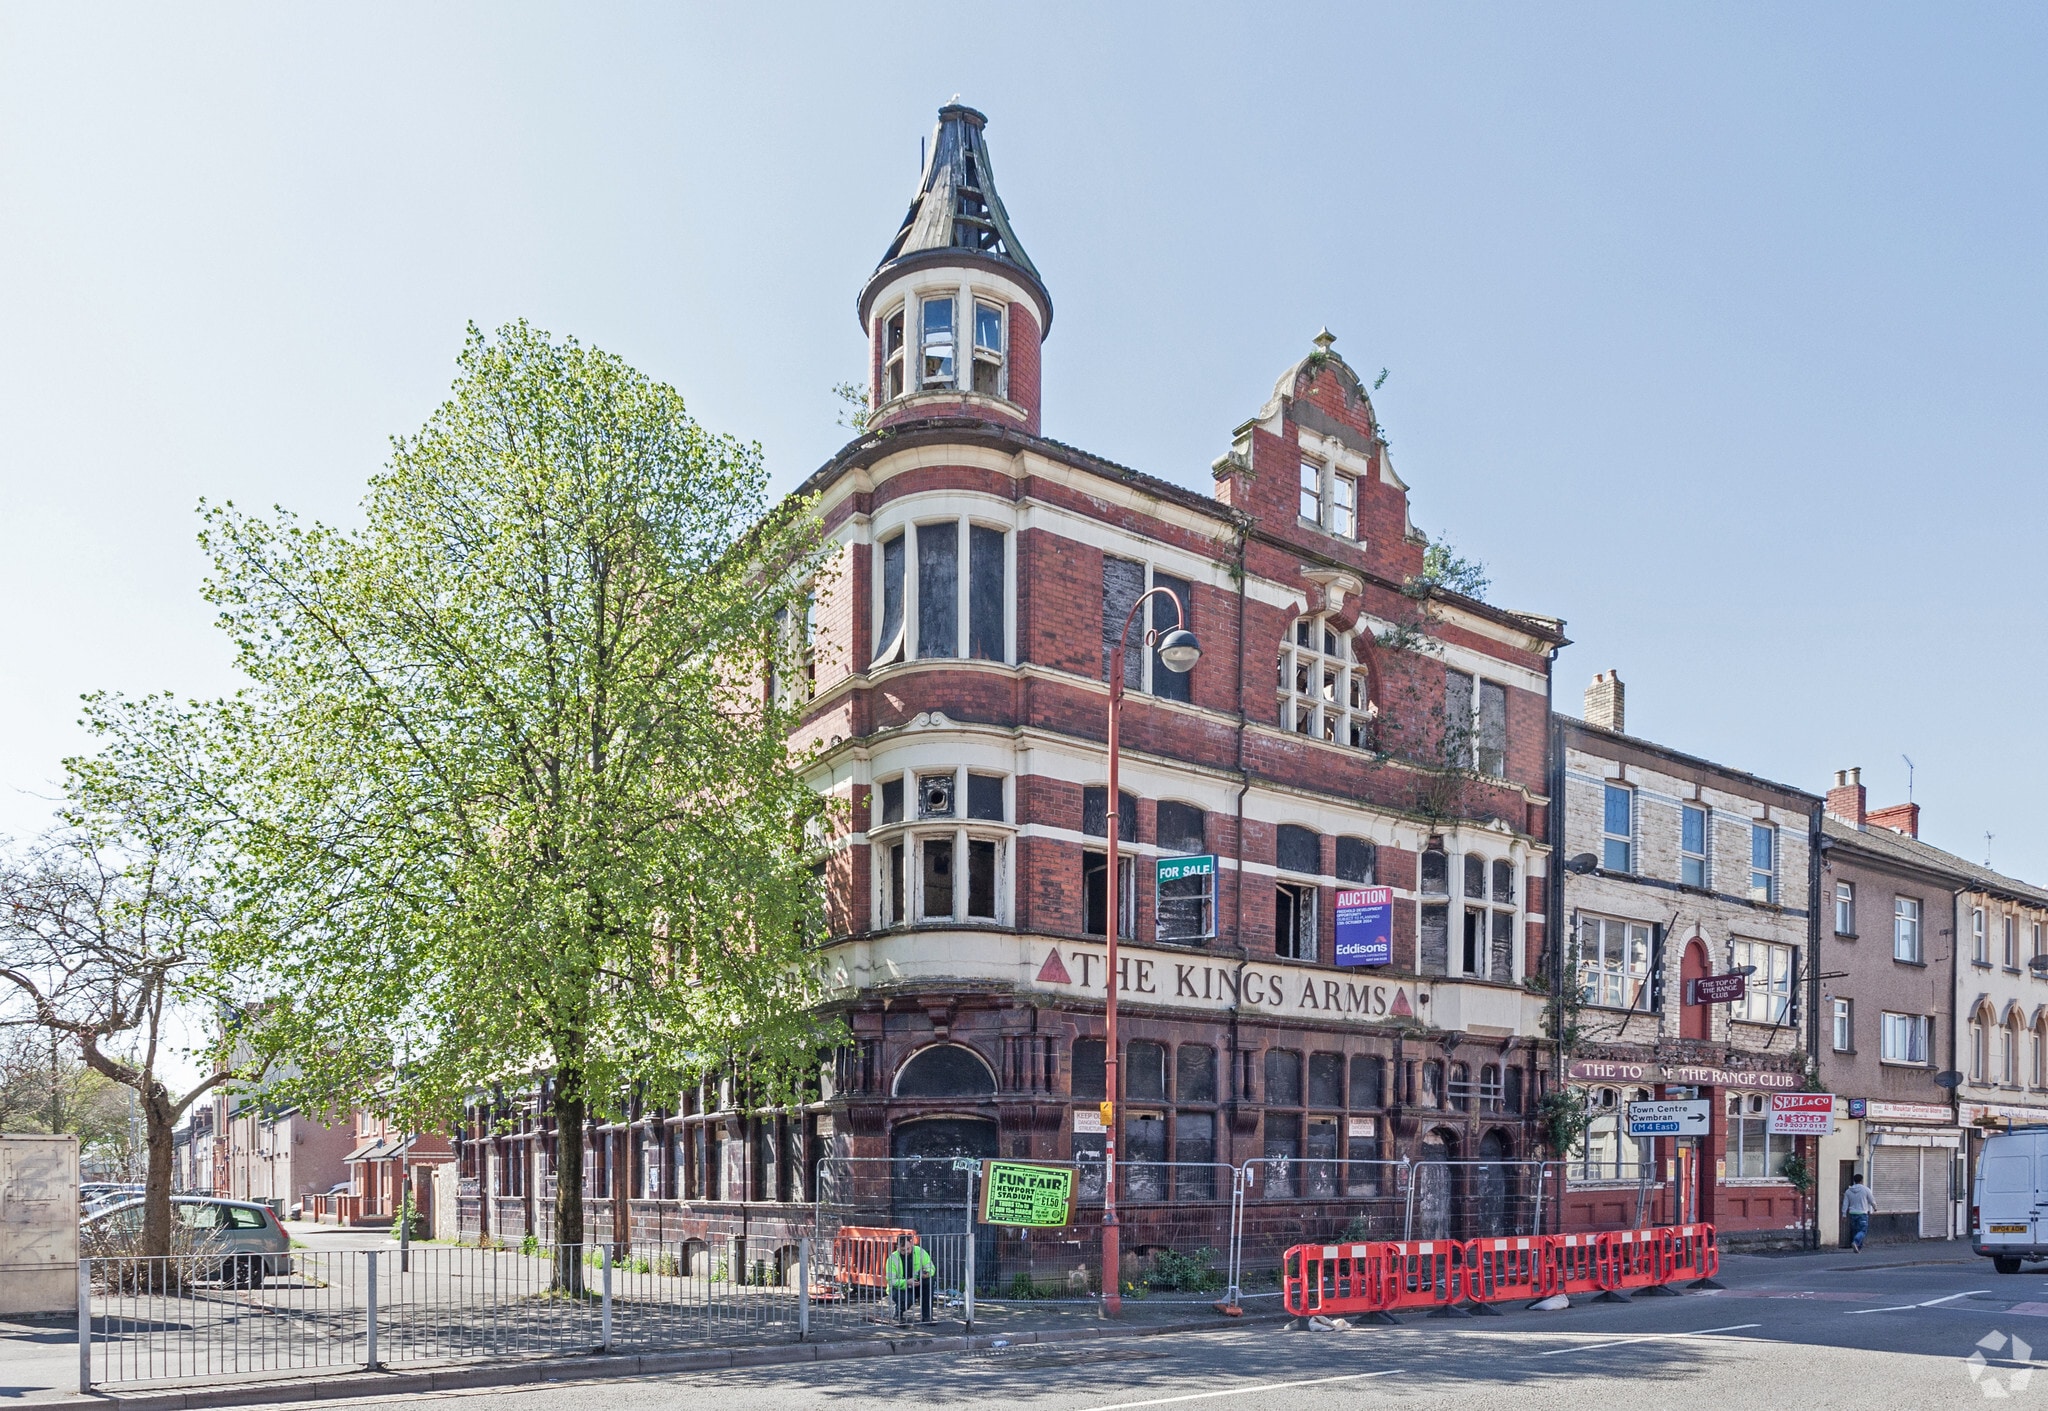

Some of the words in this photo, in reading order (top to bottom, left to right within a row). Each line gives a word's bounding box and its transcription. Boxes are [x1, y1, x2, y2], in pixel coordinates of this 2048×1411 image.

[1160, 867, 1179, 879] FOR
[1183, 865, 1210, 877] SALE
[1338, 889, 1386, 906] AUCTION
[1336, 943, 1388, 955] Eddisons
[1072, 952, 1156, 993] THE
[1175, 963, 1283, 1006] KINGS
[1298, 977, 1386, 1016] ARMS
[1583, 1063, 1616, 1077] THE
[1619, 1065, 1643, 1079] TO
[1679, 1068, 1708, 1081] THE
[1711, 1070, 1757, 1086] RANGE
[1760, 1074, 1794, 1087] CLUB
[1657, 1105, 1688, 1113] Centre
[1773, 1095, 1807, 1110] SEEL
[1655, 1122, 1679, 1131] East)
[999, 1172, 1026, 1186] FUN
[1029, 1178, 1062, 1190] FAIR
[996, 1185, 1035, 1195] NEWPORT
[997, 1192, 1033, 1201] STADIUM
